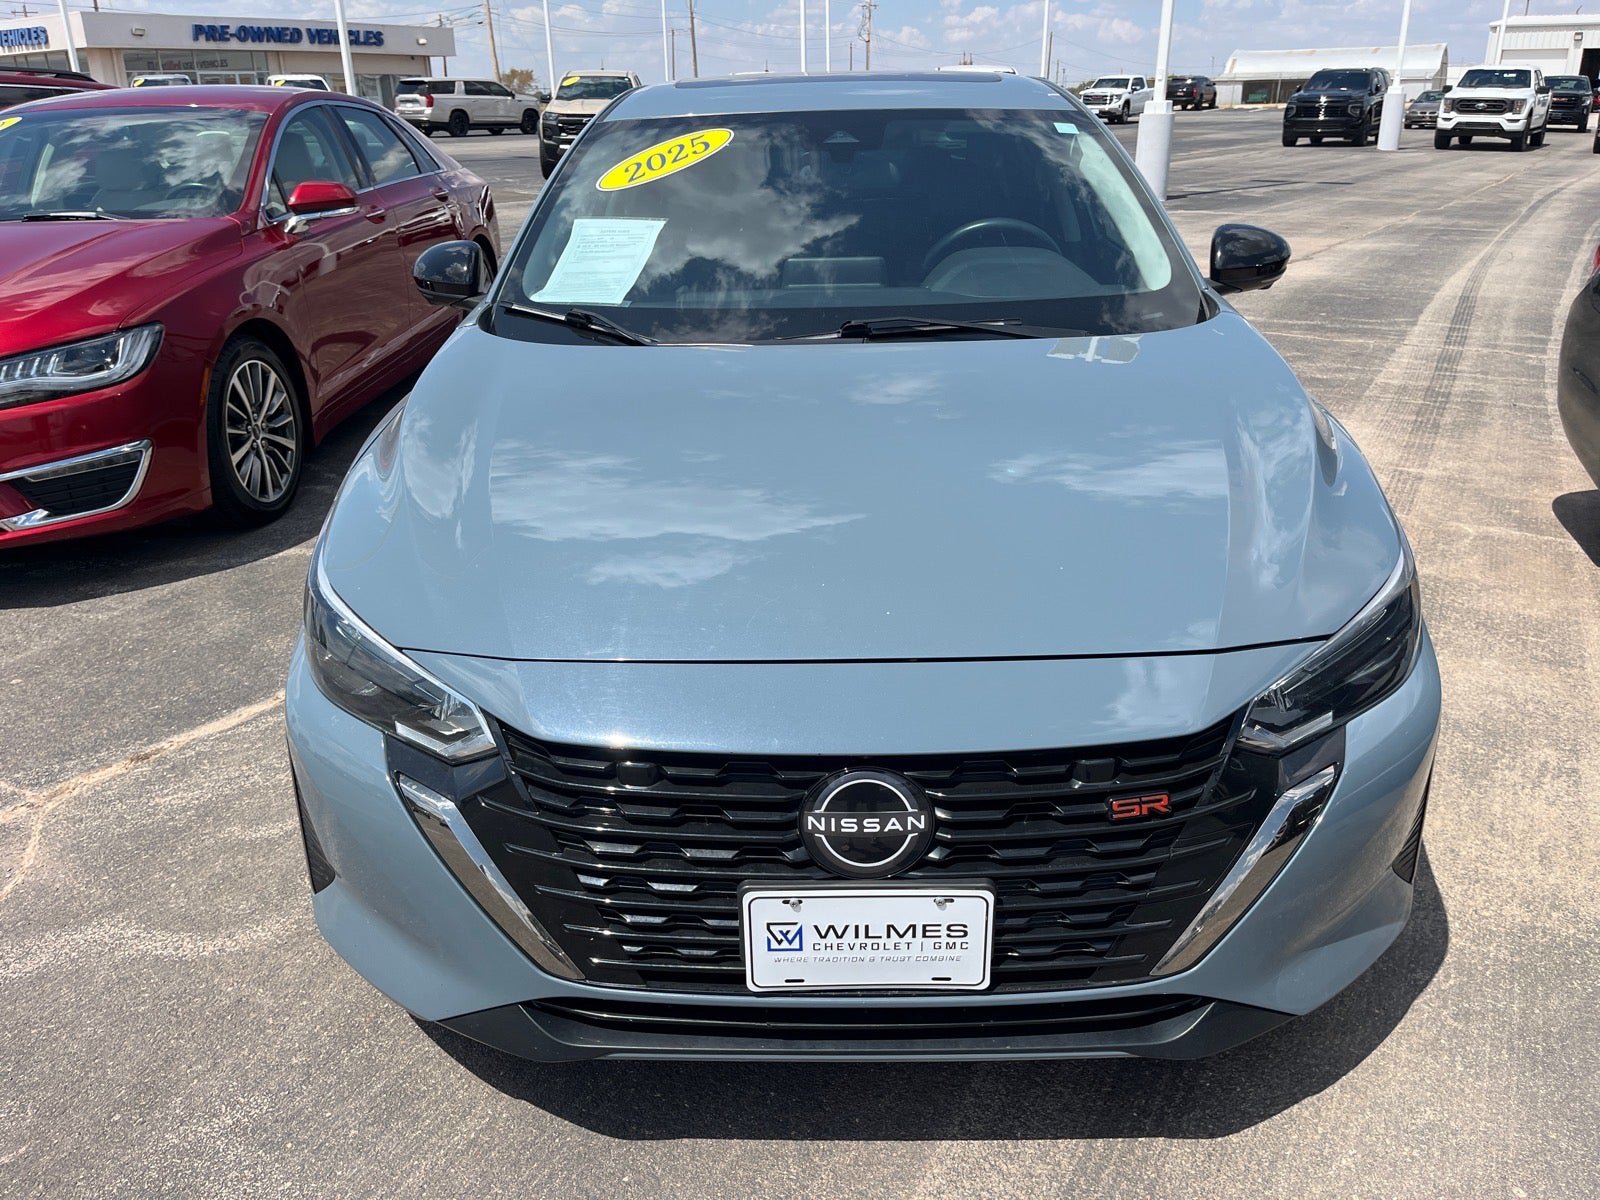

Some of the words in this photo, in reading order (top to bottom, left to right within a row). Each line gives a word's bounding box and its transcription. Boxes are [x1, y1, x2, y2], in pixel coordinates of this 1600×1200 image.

[0, 26, 48, 47] EHICLES
[192, 24, 303, 43] PRE-OWNED
[306, 28, 384, 46] VEHCLES
[624, 135, 710, 182] 2025
[1112, 794, 1169, 819] SR
[807, 815, 925, 832] NISSAN
[813, 923, 969, 939] WILMES
[812, 942, 912, 951] CHEVROLET
[933, 941, 969, 950] GMC
